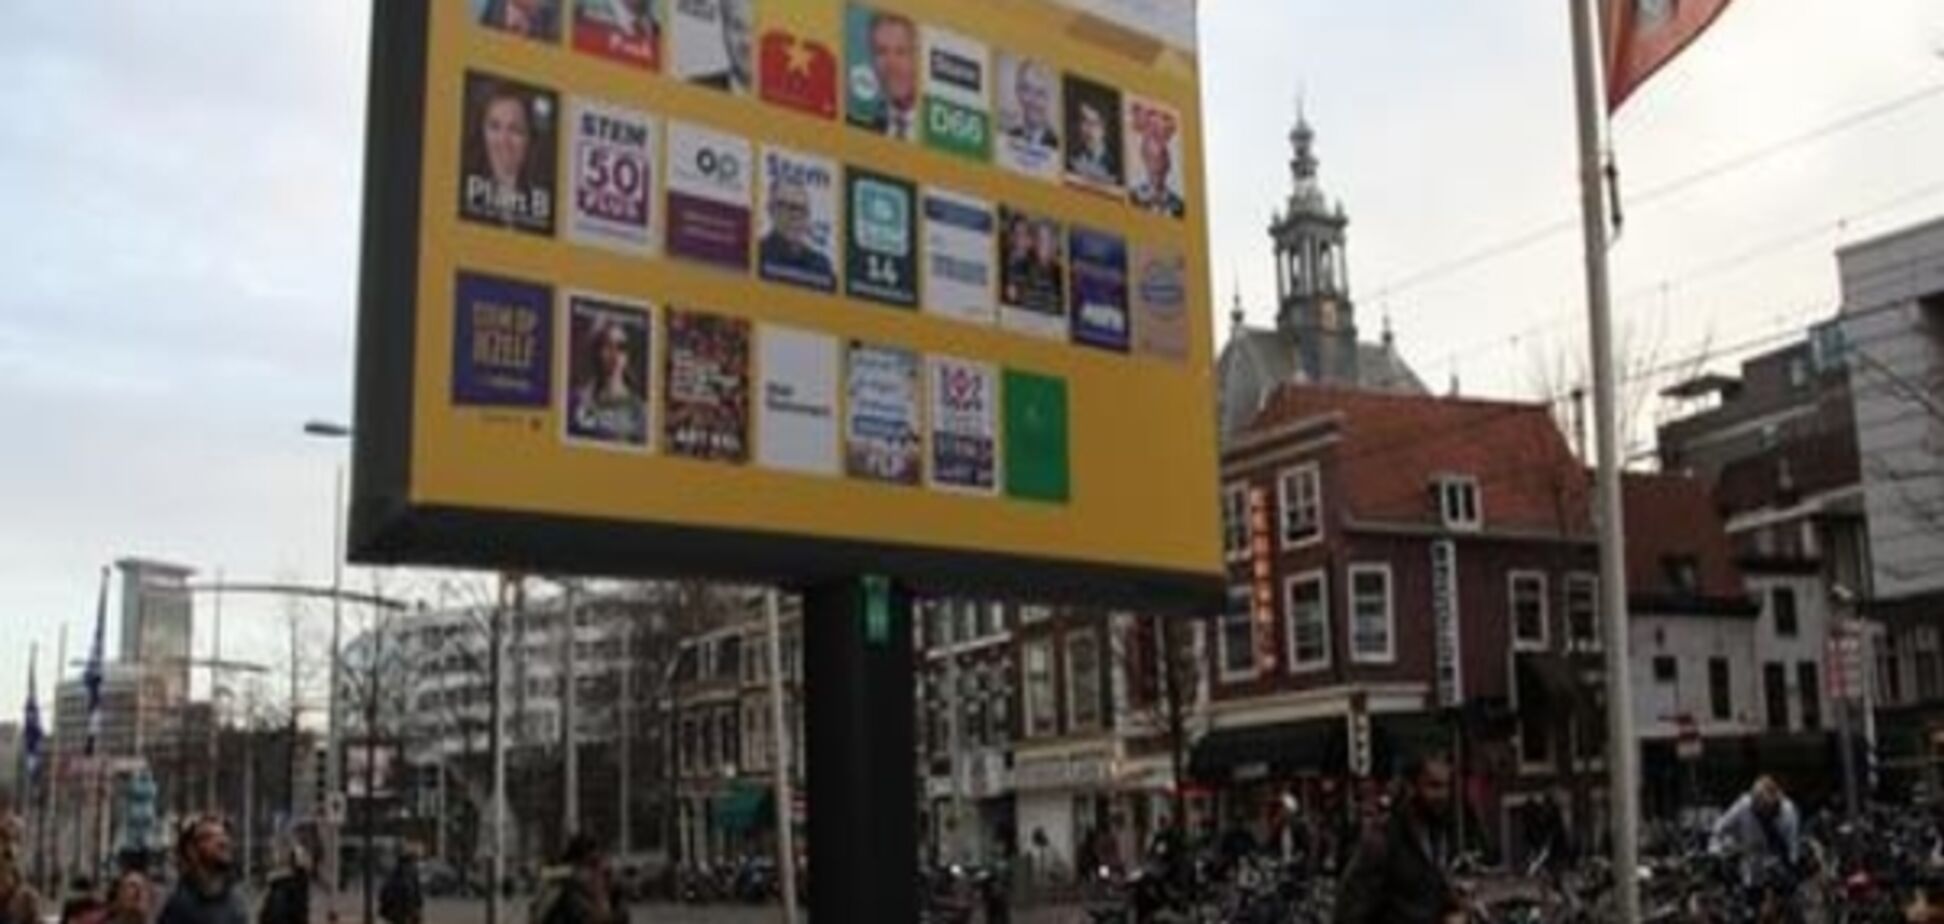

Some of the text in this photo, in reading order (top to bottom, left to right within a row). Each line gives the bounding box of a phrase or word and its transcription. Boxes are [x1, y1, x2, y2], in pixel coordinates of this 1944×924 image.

[581, 111, 648, 147] STEM
[929, 102, 986, 145] D66
[585, 147, 641, 196] 50
